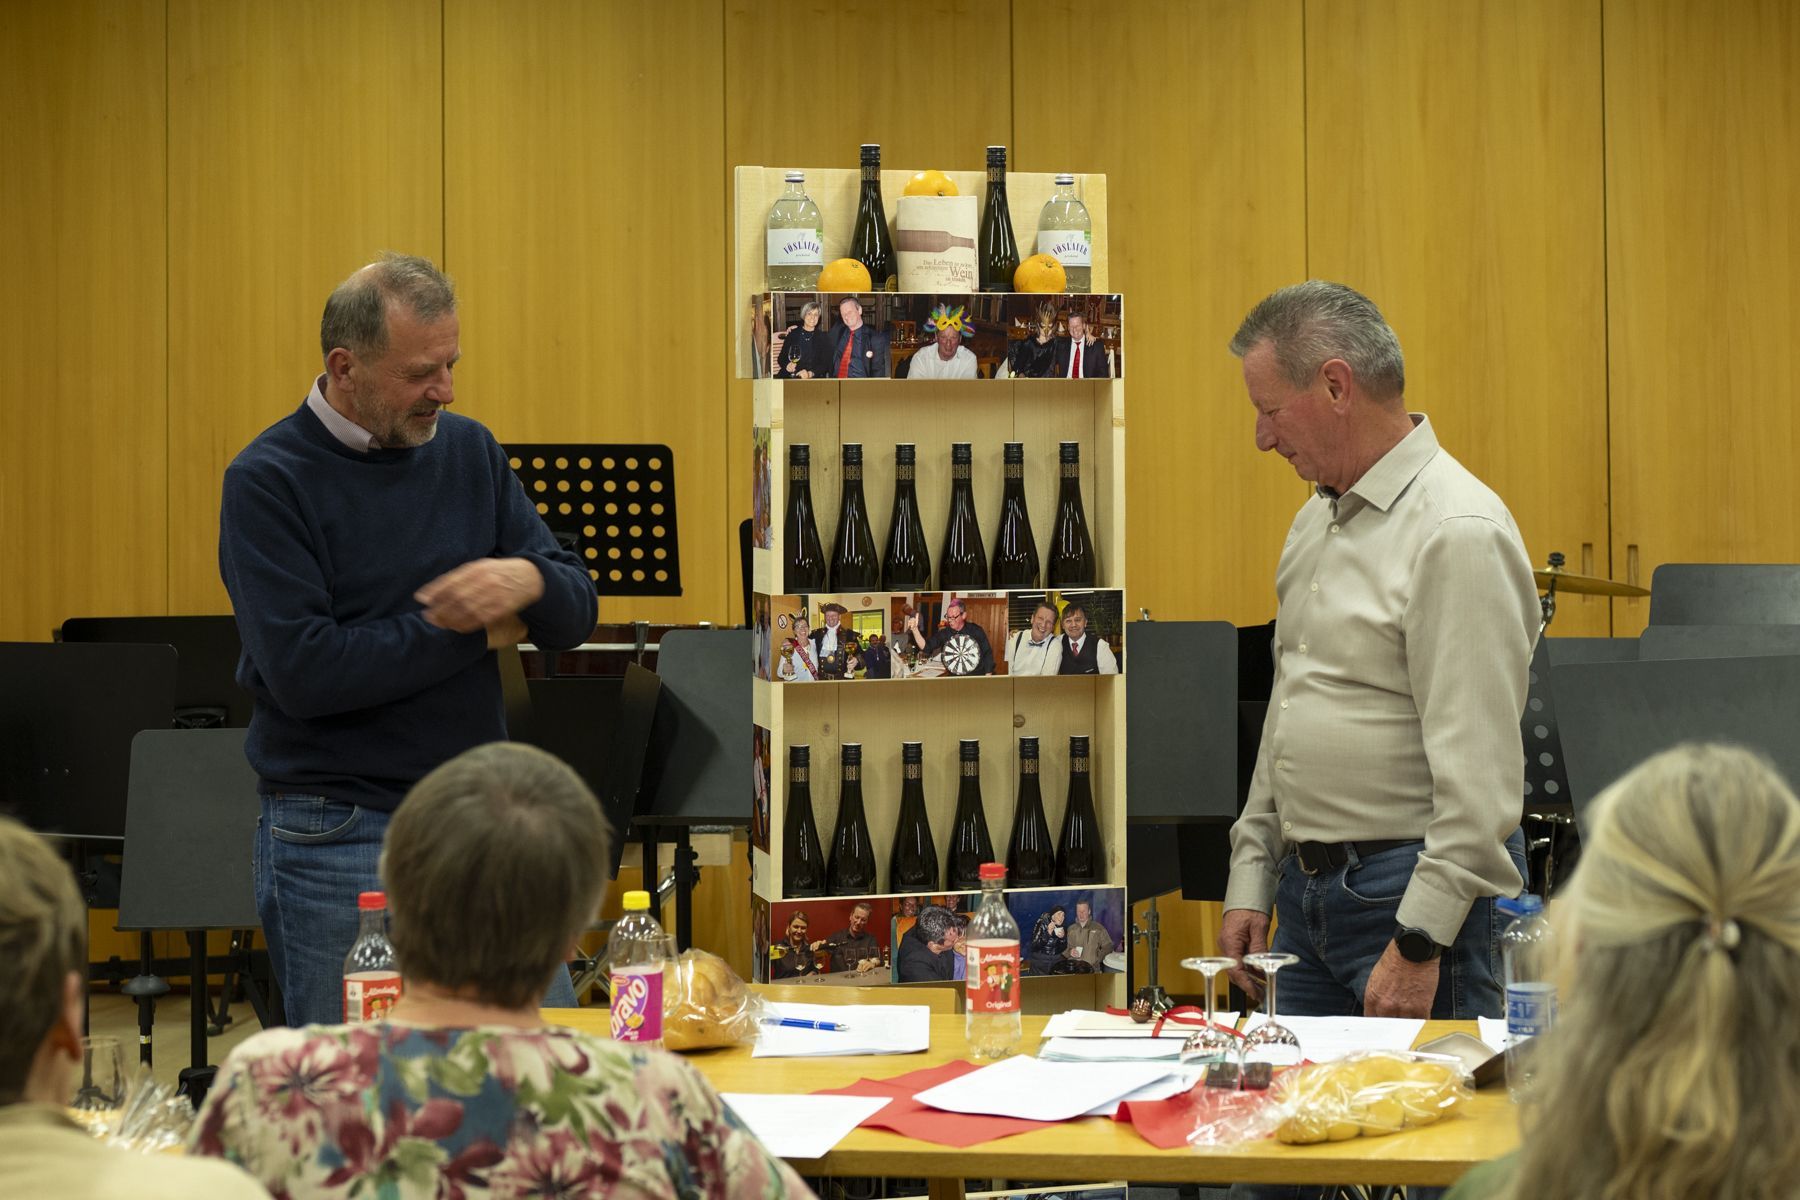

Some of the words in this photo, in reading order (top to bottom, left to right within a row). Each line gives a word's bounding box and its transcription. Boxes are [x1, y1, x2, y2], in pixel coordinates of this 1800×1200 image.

[783, 240, 820, 255] VÖSLAUER
[949, 266, 973, 280] Wein
[985, 1000, 1012, 1010] Original
